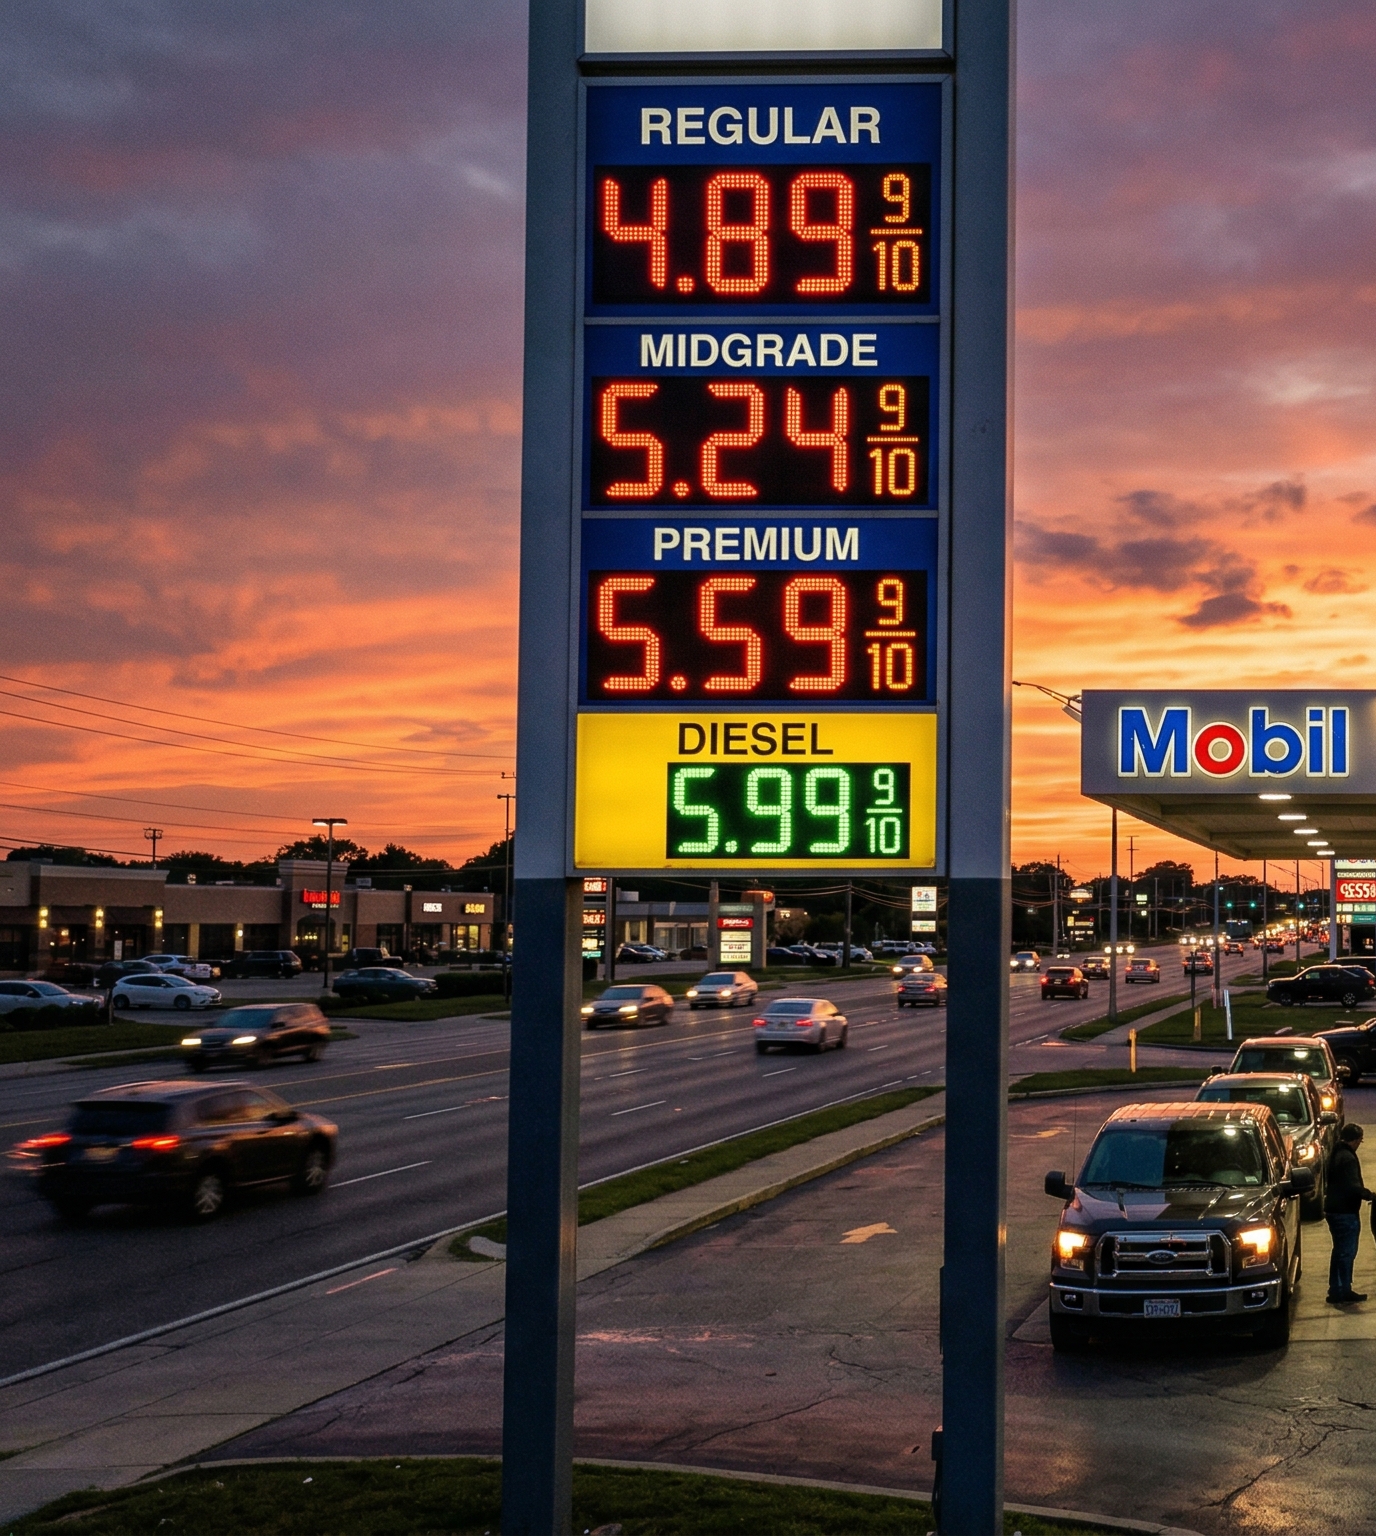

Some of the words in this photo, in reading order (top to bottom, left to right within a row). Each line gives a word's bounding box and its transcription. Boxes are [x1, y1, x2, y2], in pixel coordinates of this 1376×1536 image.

[641, 106, 881, 145] REGULAR
[604, 173, 855, 294] 4.89
[641, 332, 878, 368] MIDGRADE
[601, 382, 849, 499] 5.24
[654, 527, 859, 562] PREMIUM
[598, 575, 848, 692] 5.59
[678, 722, 834, 756] DIESEL
[1118, 706, 1350, 778] Mobil
[673, 767, 851, 854] 5.99
